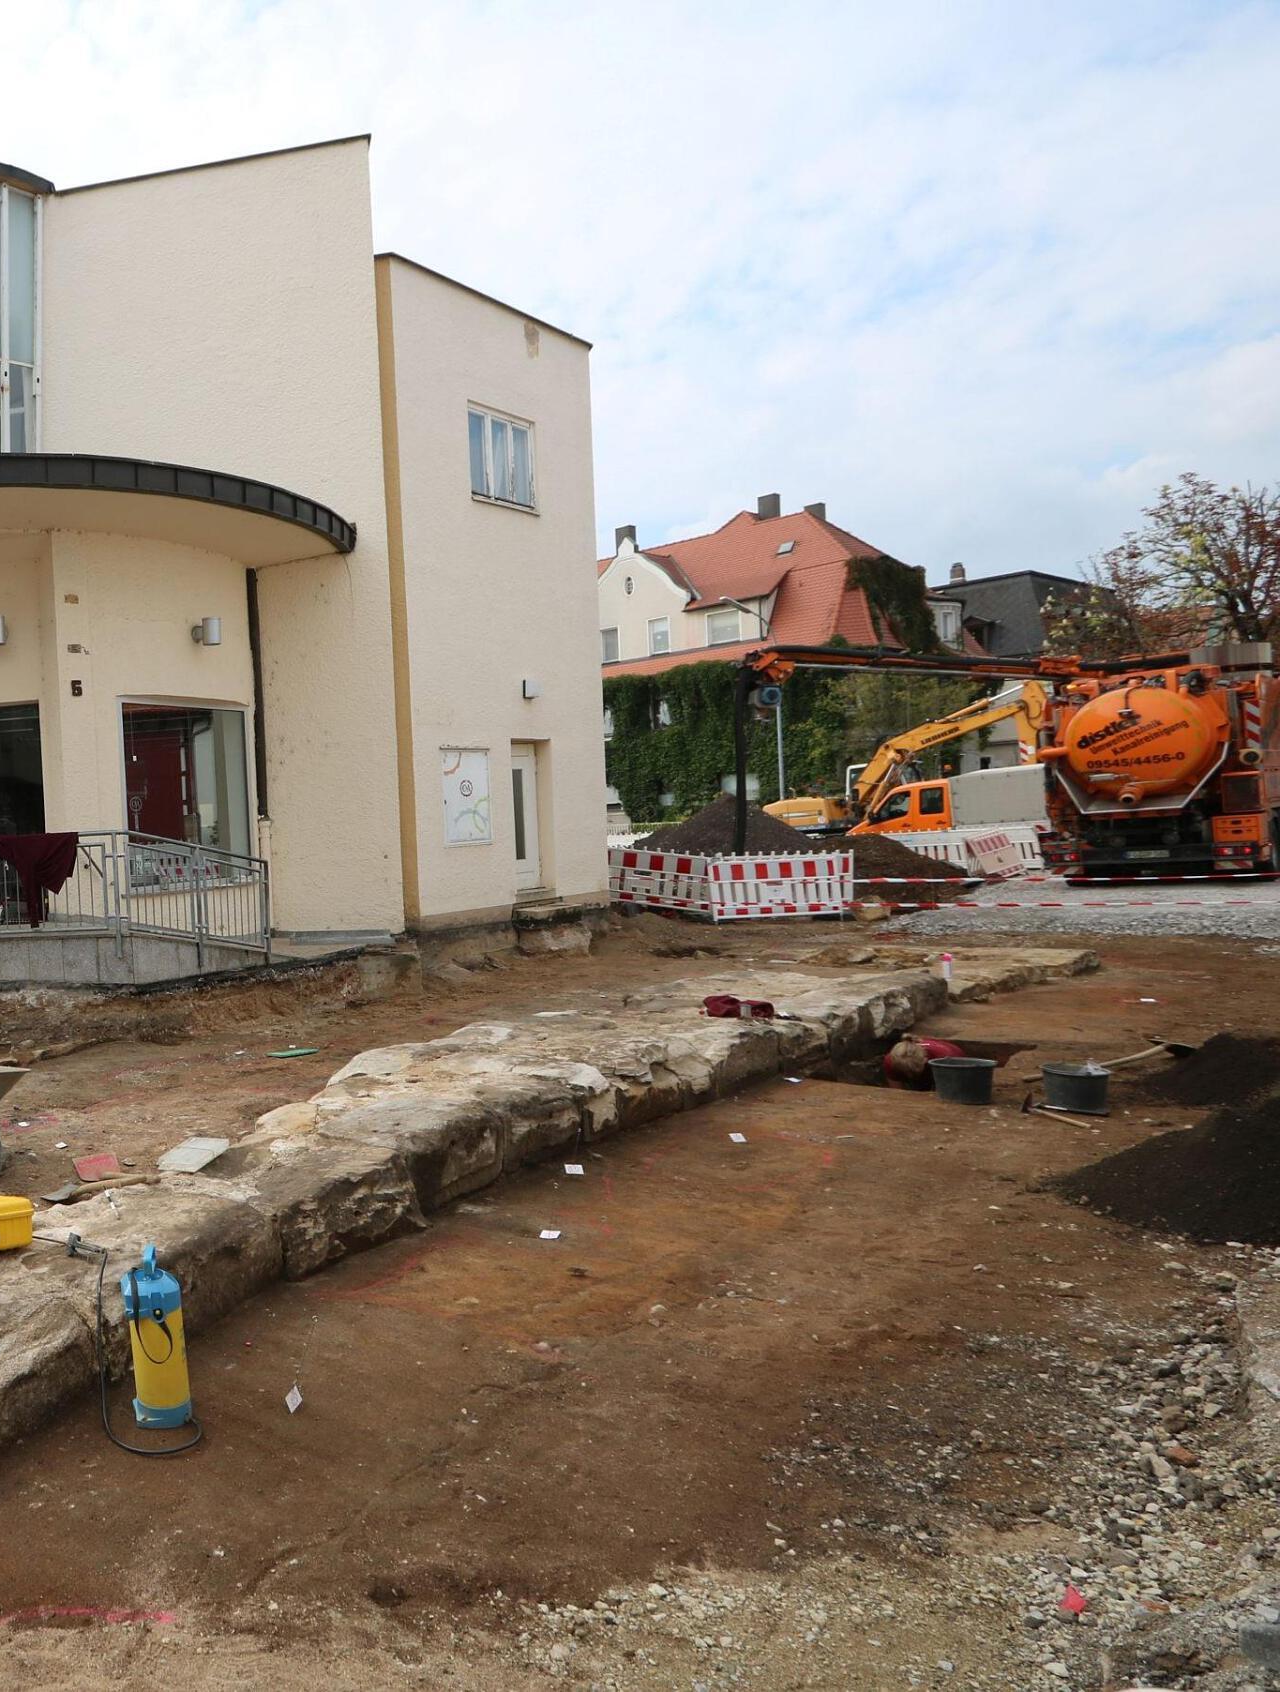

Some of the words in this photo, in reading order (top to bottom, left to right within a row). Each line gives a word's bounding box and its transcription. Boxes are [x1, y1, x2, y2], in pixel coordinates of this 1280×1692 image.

[1089, 719, 1163, 754] Umwelttechnik
[1111, 720, 1190, 756] Kanalreinigung
[1086, 752, 1185, 769] 09545/4456-0
